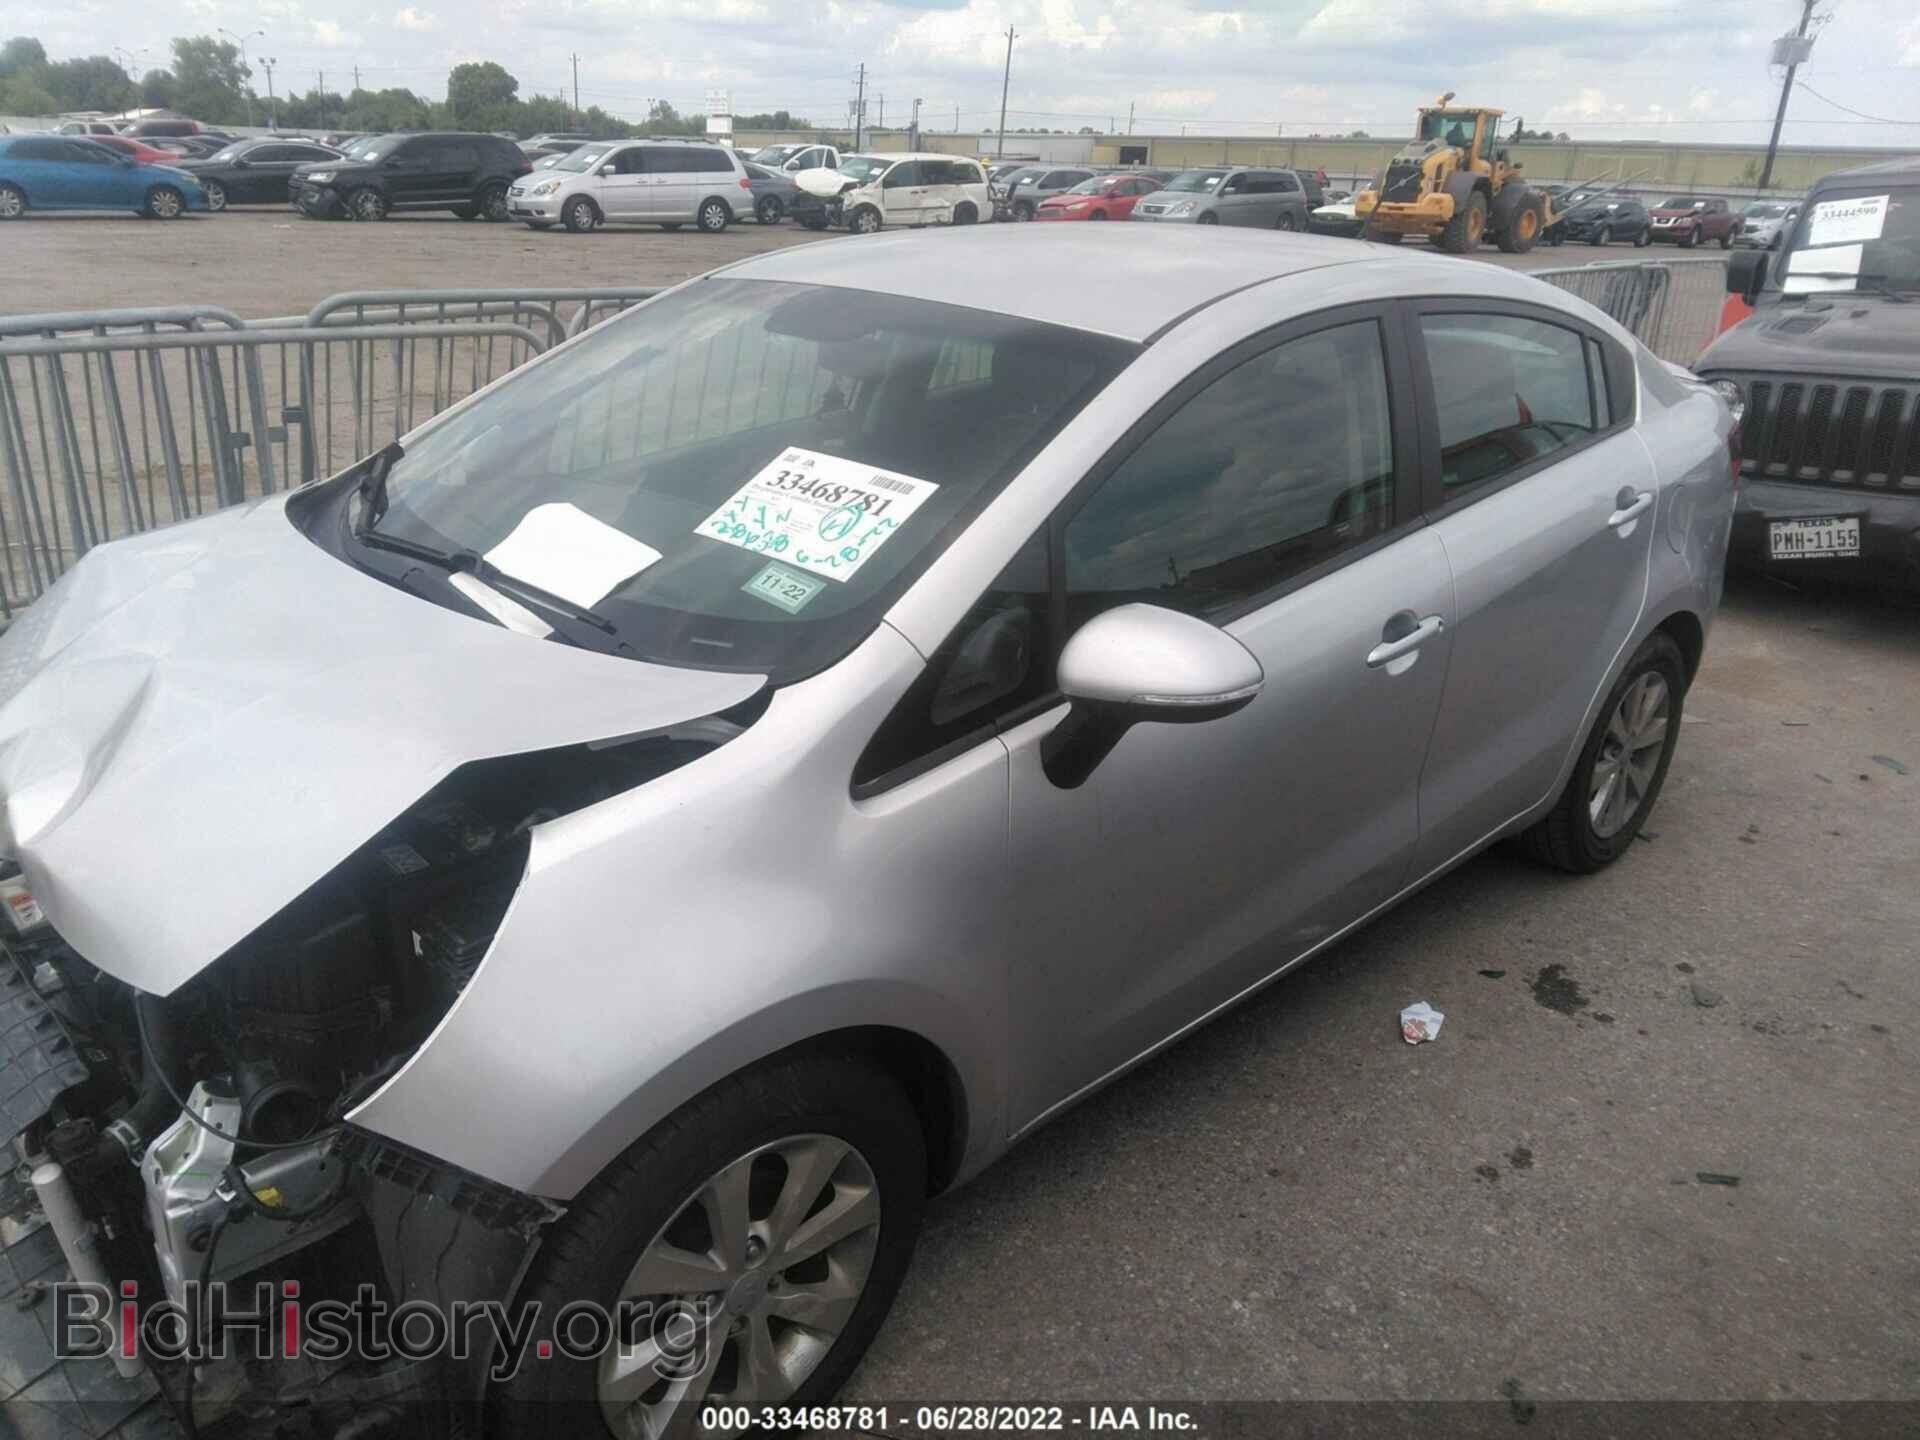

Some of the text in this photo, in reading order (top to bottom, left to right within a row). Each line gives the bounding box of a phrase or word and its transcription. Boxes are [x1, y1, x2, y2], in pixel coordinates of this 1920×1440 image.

[766, 470, 893, 516] 33468781
[1773, 529, 1857, 551] PMH-1155
[761, 575, 807, 601] 11-22
